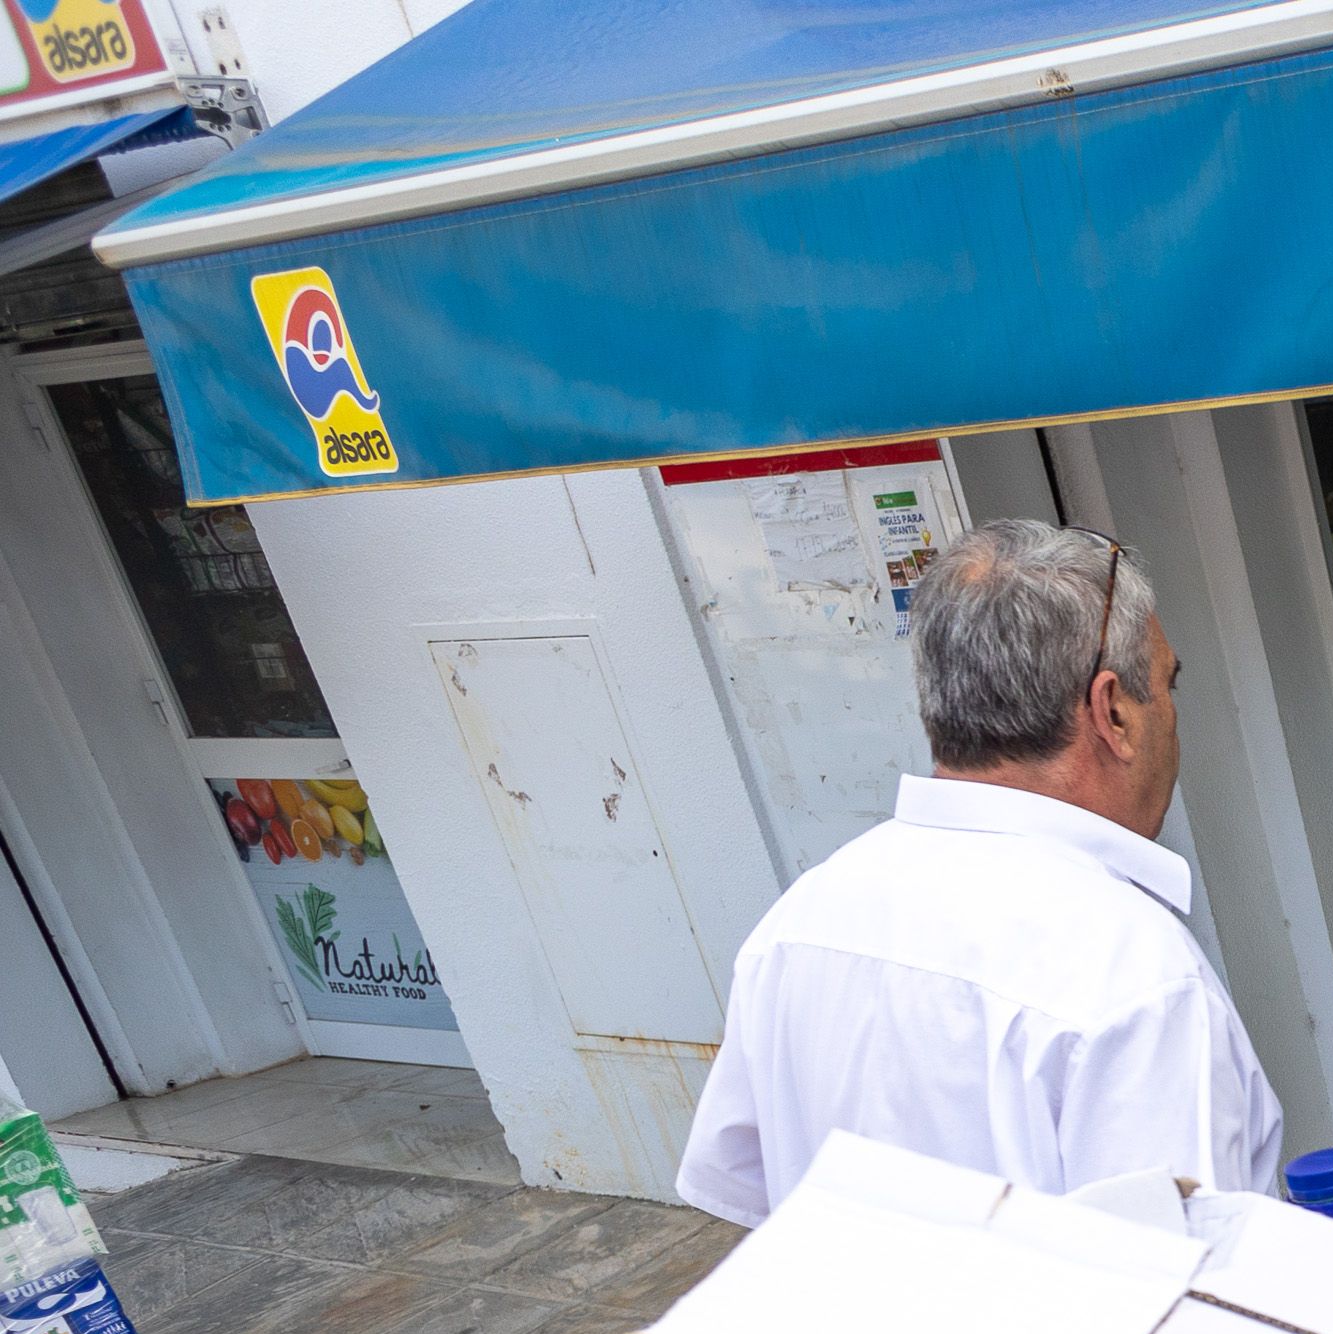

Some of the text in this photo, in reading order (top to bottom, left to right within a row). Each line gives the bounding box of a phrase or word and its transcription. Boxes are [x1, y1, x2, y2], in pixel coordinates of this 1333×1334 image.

[44, 21, 127, 73] alsara
[323, 427, 391, 465] alsara
[888, 525, 920, 536] INFANTIL
[902, 512, 925, 523] PARA
[328, 981, 427, 1000] HEALTHY FOOD
[4, 1268, 81, 1304] PULEVA
